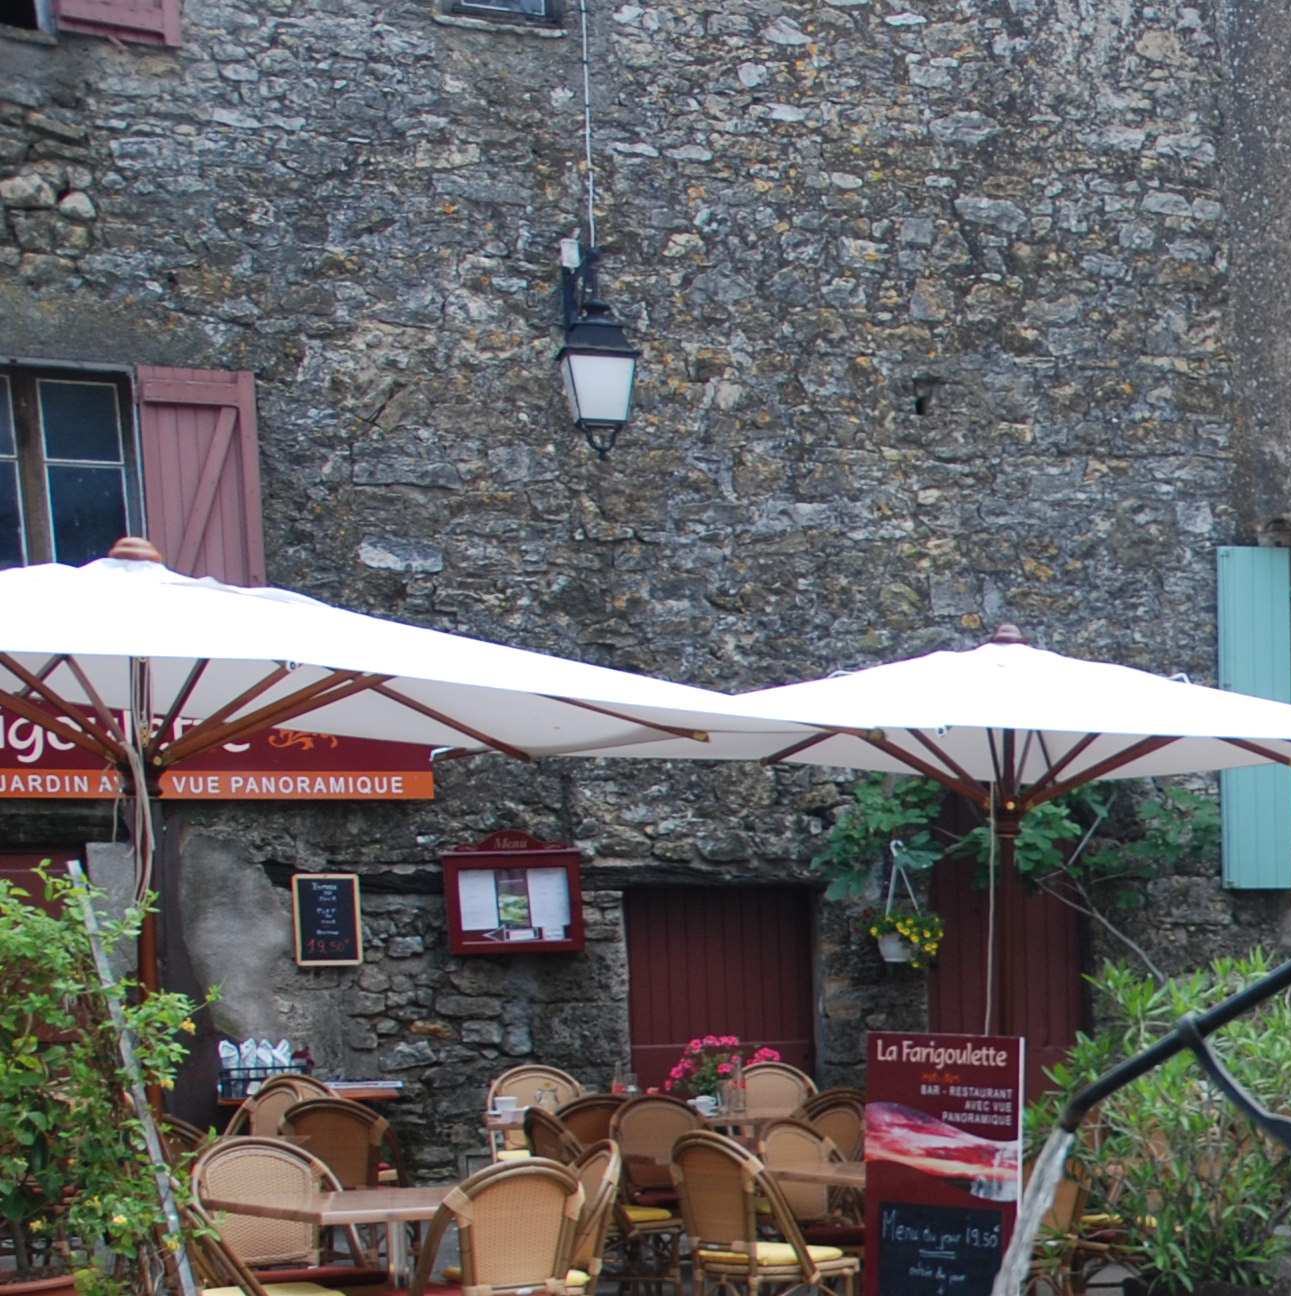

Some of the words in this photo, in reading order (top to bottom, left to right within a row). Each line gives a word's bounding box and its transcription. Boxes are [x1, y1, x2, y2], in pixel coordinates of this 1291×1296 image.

[0, 775, 88, 792] JARDIN
[172, 776, 221, 793] VUE
[231, 776, 403, 794] PANORAMIQUE
[493, 838, 528, 849] Menu
[877, 1039, 897, 1061] La
[902, 1040, 1008, 1069] Farigoulette
[921, 1084, 940, 1095] BAR
[949, 1086, 1013, 1098] RESTAURANT
[965, 1101, 990, 1111] AVEC
[993, 1102, 1012, 1112] VUE
[942, 1111, 1012, 1126] PANORAMIQUE
[882, 1209, 919, 1240] Menu
